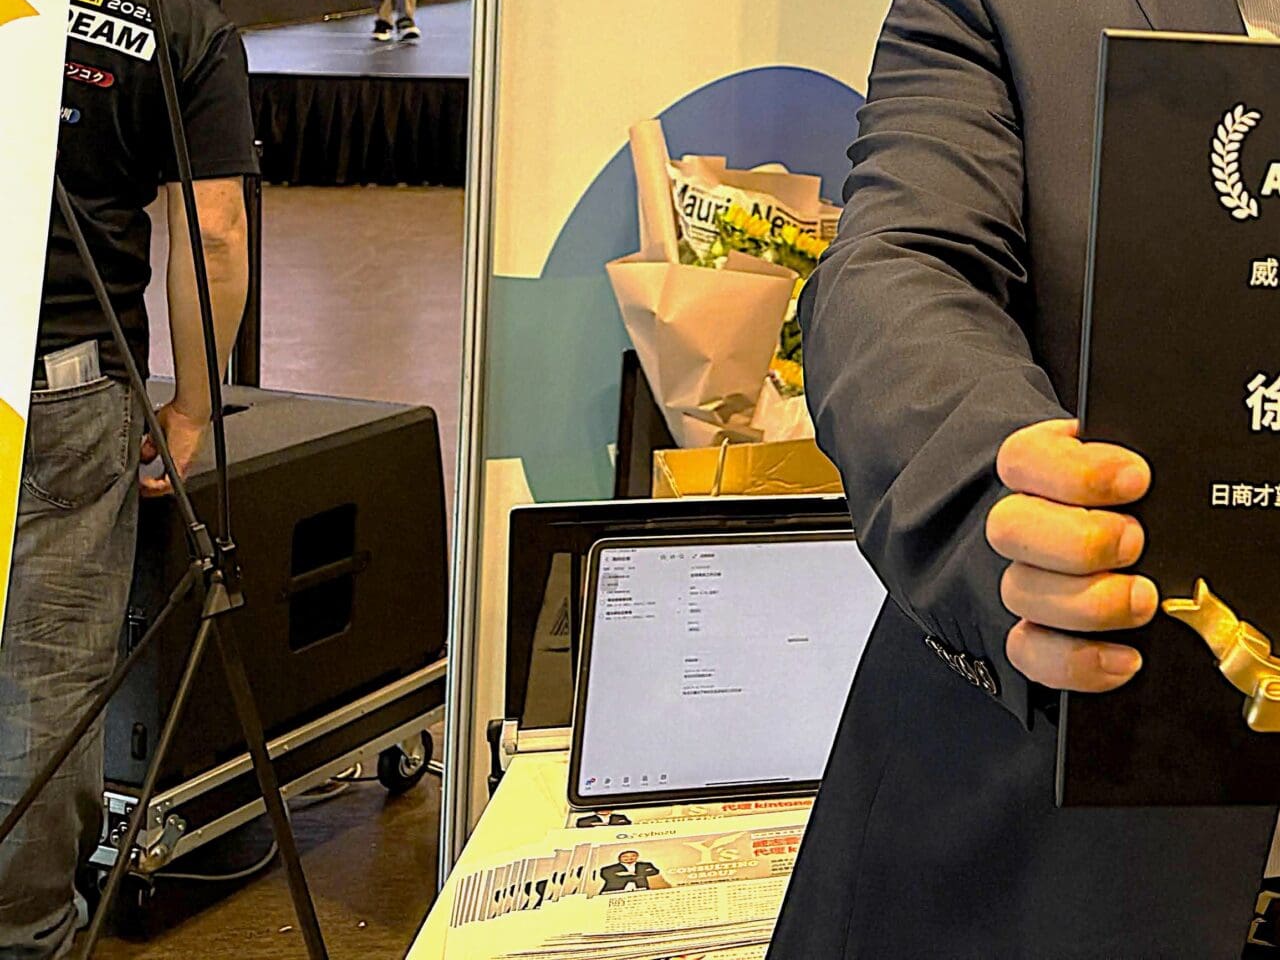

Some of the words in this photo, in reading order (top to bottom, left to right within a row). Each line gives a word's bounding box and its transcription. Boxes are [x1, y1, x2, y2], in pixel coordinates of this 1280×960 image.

[68, 8, 149, 54] EAM
[65, 62, 104, 83] ンコク
